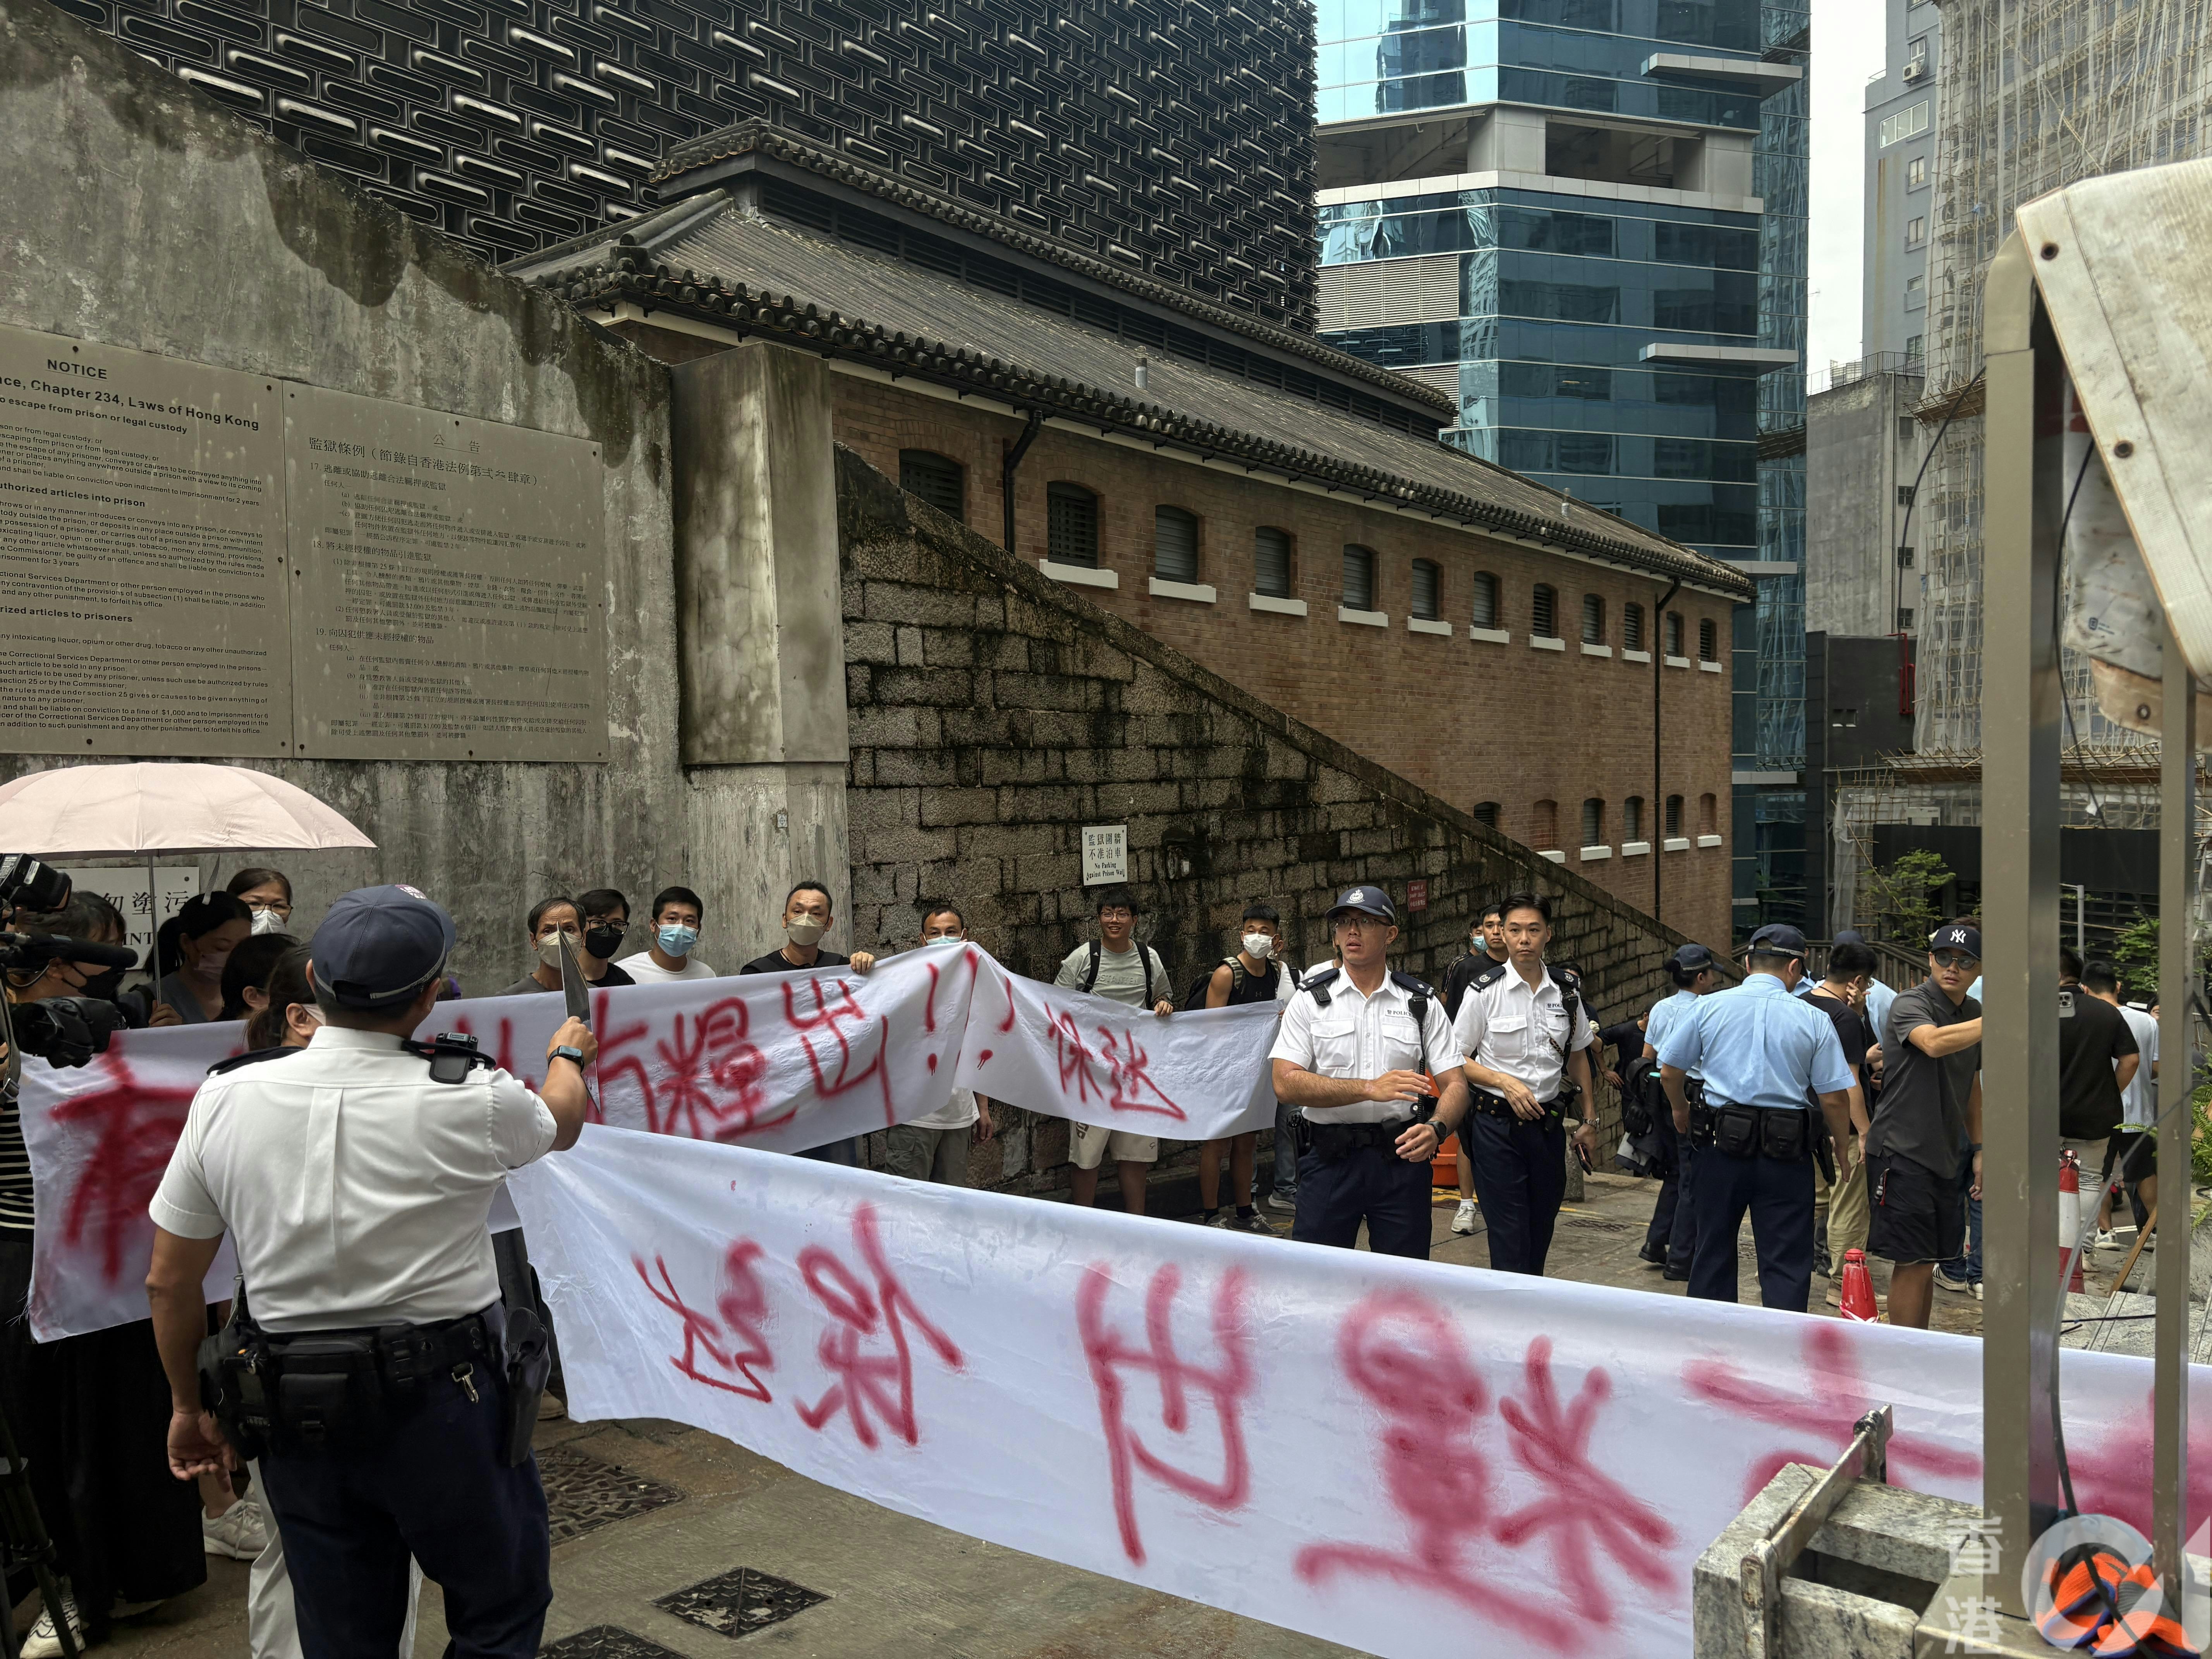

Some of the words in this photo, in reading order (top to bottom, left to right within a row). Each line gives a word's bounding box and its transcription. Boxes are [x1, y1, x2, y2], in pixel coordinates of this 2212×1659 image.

[47, 358, 107, 380] NOTICE
[30, 379, 91, 399] Chapter
[94, 390, 124, 407] 234,
[128, 396, 165, 412] Laws
[168, 405, 183, 415] of
[185, 406, 221, 424] Hong
[224, 413, 259, 431] Kong
[8, 398, 46, 410] escape
[48, 403, 72, 414] from
[75, 409, 108, 419] prison
[122, 415, 146, 426] legal
[148, 421, 187, 434] custody
[50, 489, 89, 500] articles
[91, 493, 111, 503] into
[113, 497, 145, 507] prison
[29, 608, 69, 617] articles
[71, 610, 82, 618] to
[84, 612, 133, 622] prisoners
[1089, 847, 1121, 860] 不准泊車
